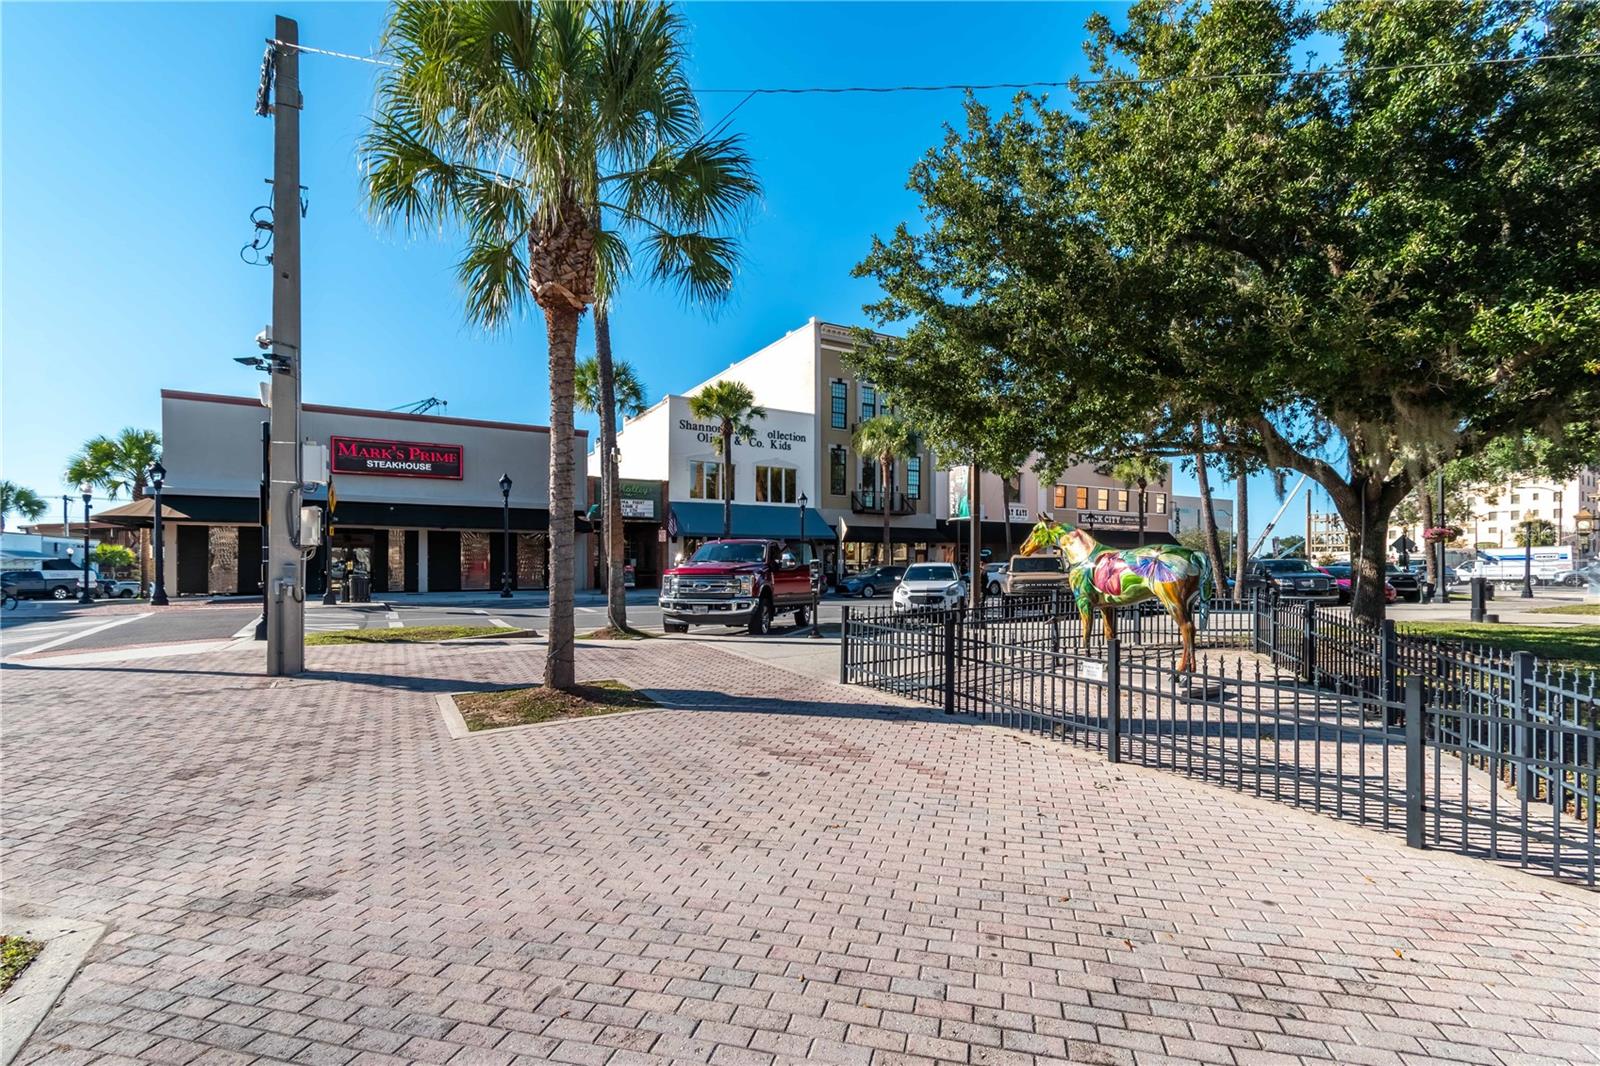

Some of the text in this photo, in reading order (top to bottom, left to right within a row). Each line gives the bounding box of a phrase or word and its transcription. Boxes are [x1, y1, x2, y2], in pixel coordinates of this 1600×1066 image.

[697, 432, 792, 450] Oli & Co. Kids
[337, 441, 458, 463] MARK'S PRIME
[366, 459, 432, 471] STEAKHOUSE
[1104, 515, 1121, 524] CITY
